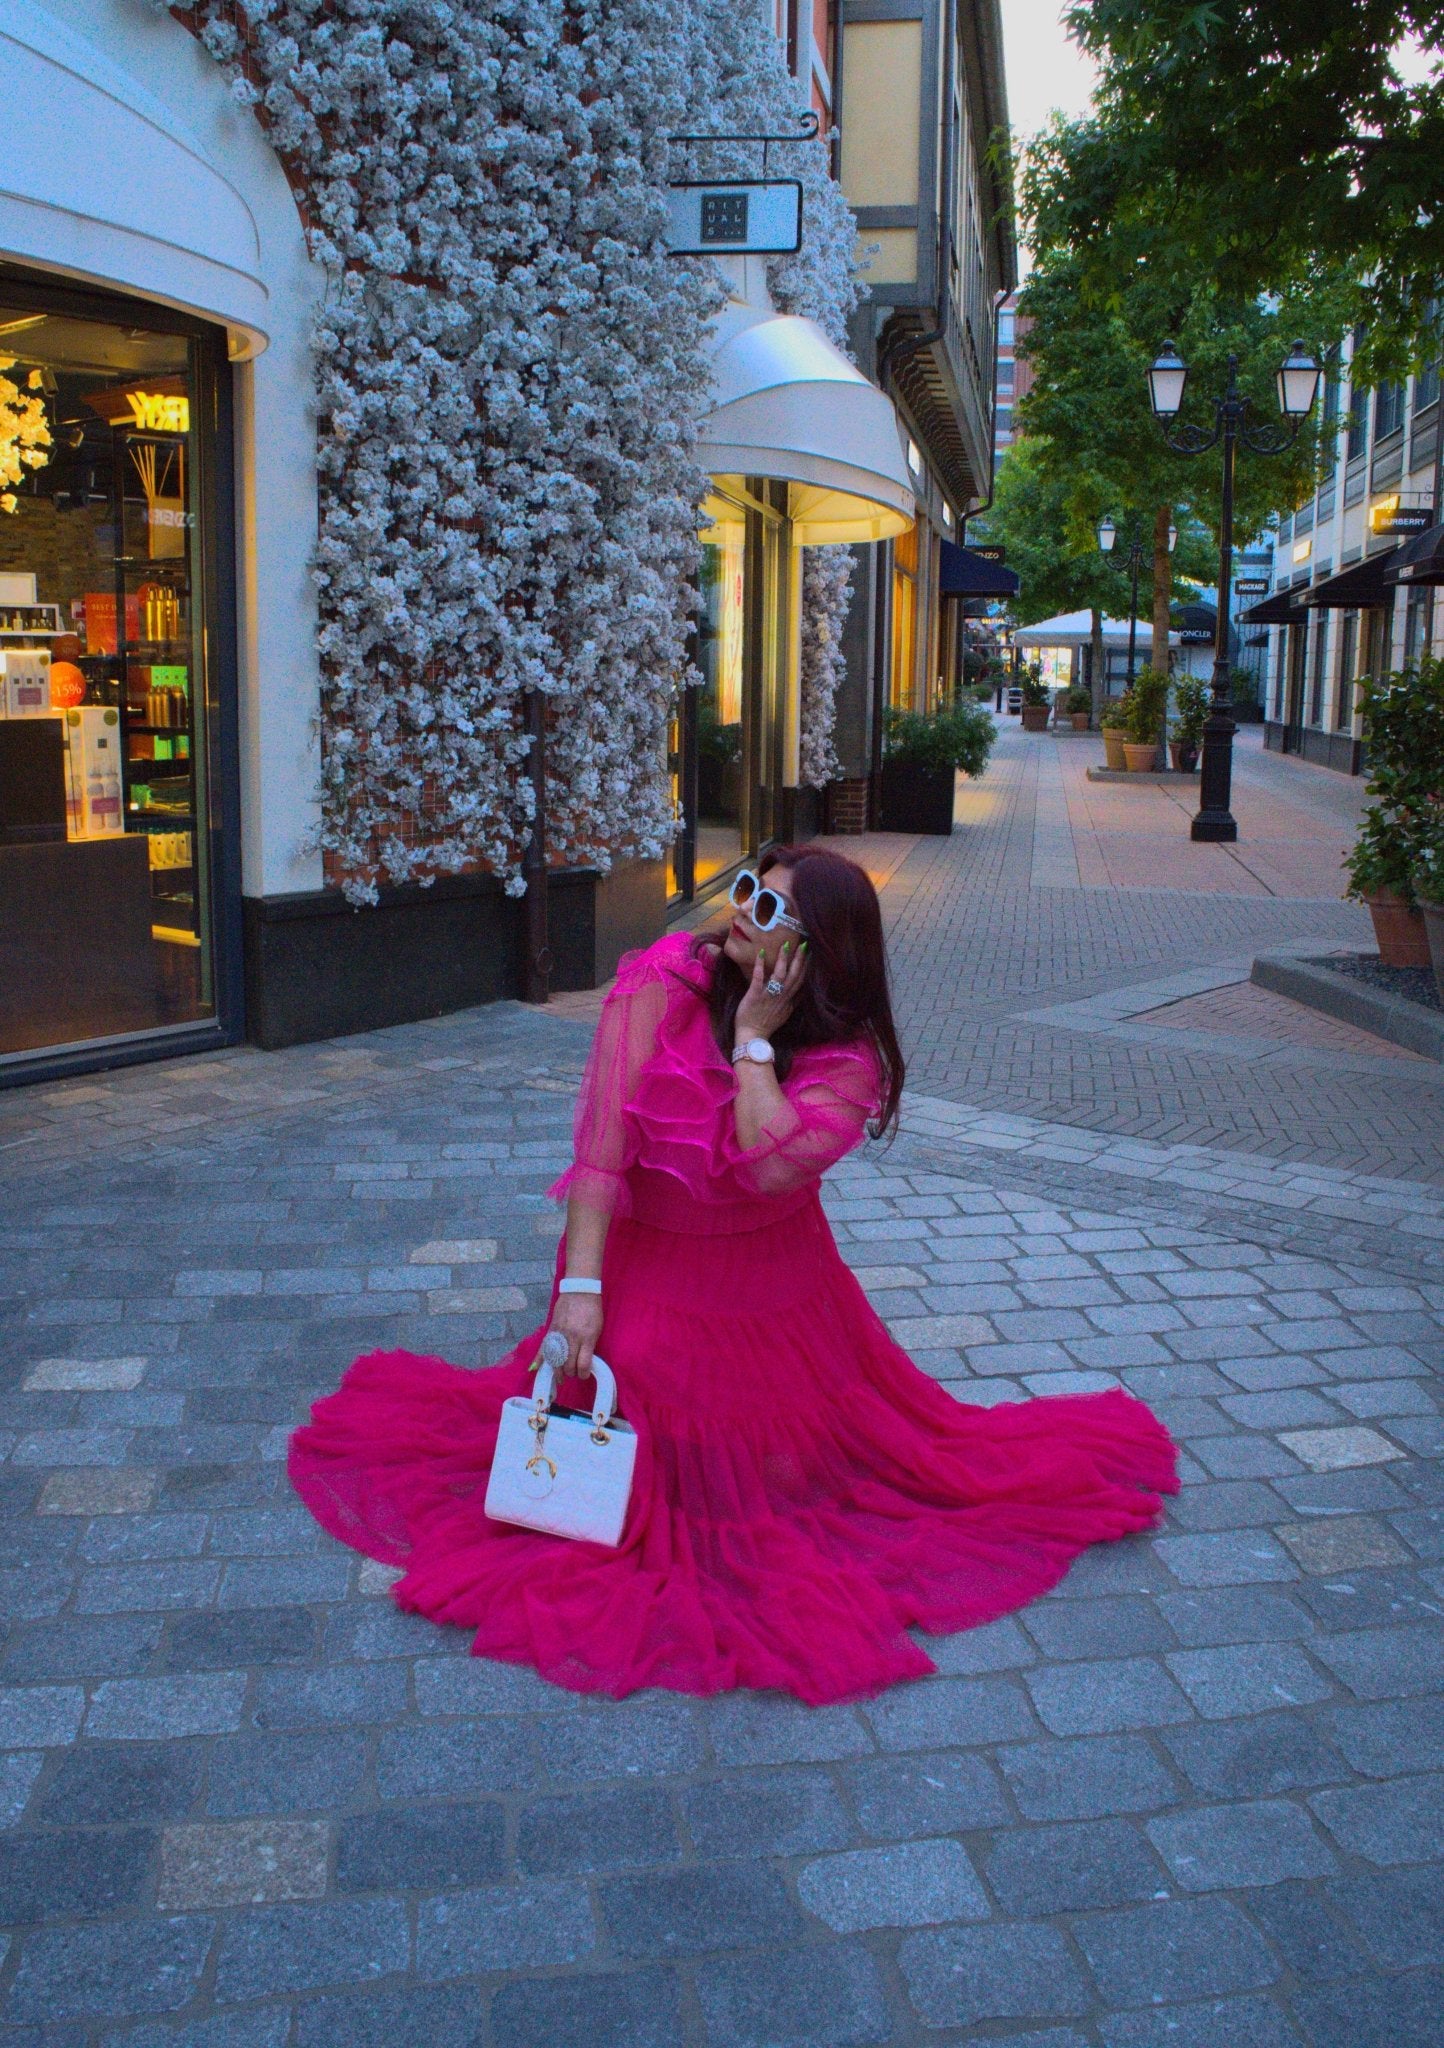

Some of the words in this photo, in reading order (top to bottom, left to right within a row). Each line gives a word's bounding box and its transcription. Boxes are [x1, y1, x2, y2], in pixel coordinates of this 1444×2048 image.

[708, 200, 742, 211] RIT
[708, 214, 742, 224] UAL
[1381, 517, 1427, 526] BURBERRY
[1238, 583, 1266, 591] MACKAGE
[51, 683, 82, 697] -15%
